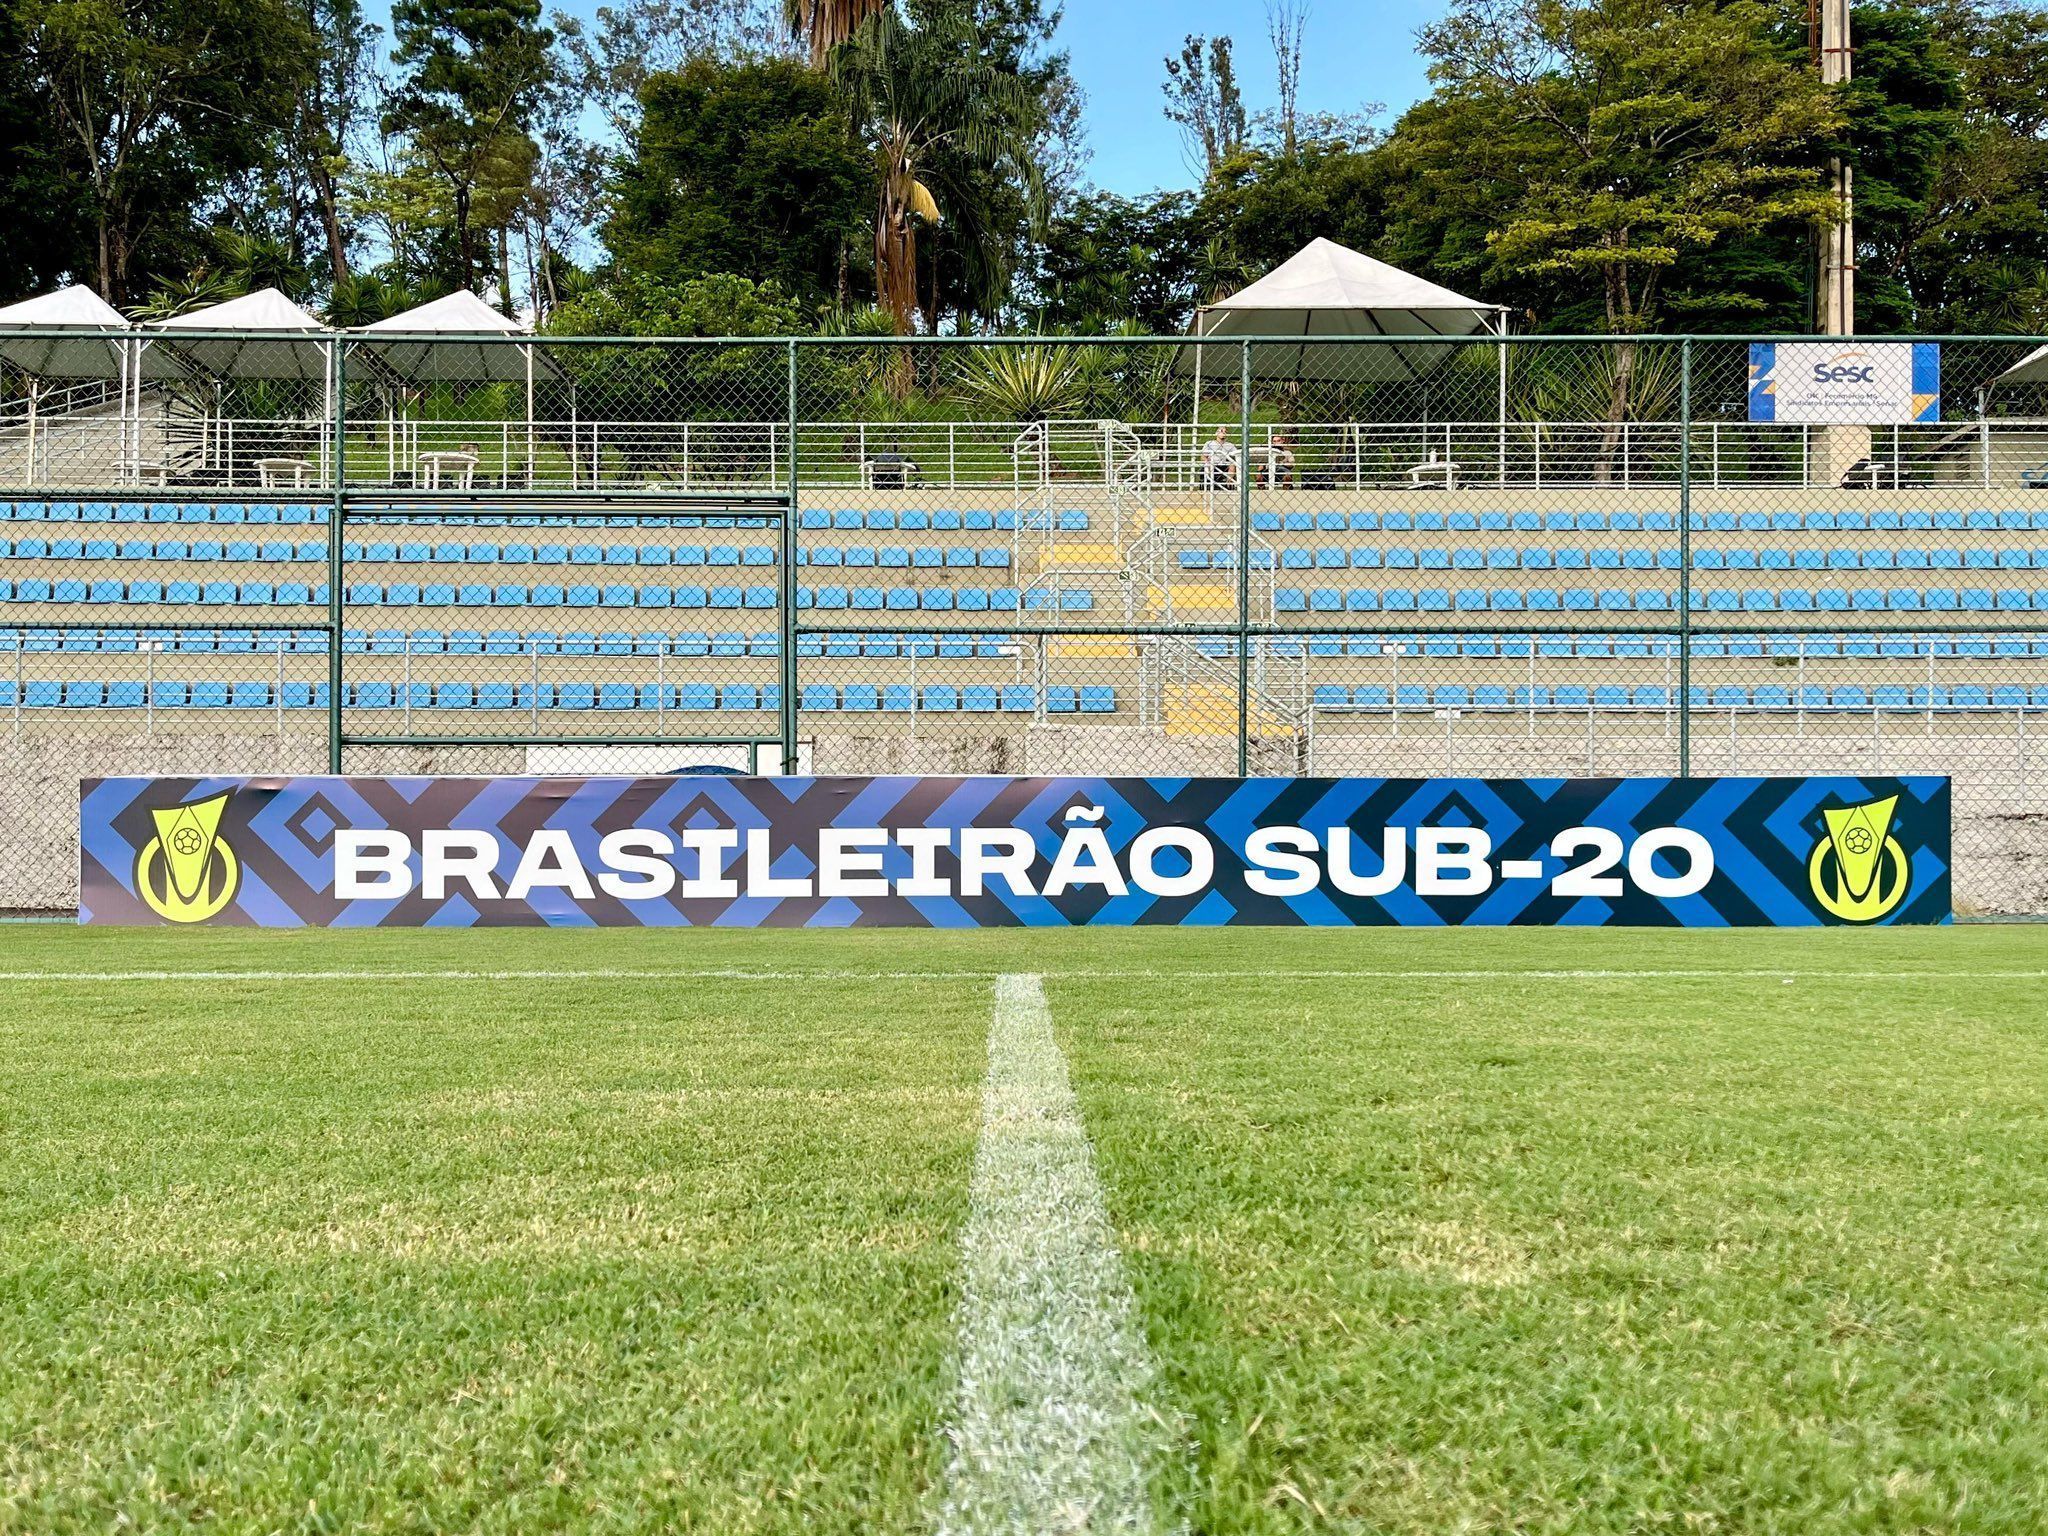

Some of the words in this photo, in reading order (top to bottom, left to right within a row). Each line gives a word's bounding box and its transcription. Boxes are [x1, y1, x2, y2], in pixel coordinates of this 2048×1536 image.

[1813, 363, 1874, 383] Sesc
[334, 806, 1213, 899] BRASILEIRÃO
[1244, 826, 1713, 897] SUB-20
